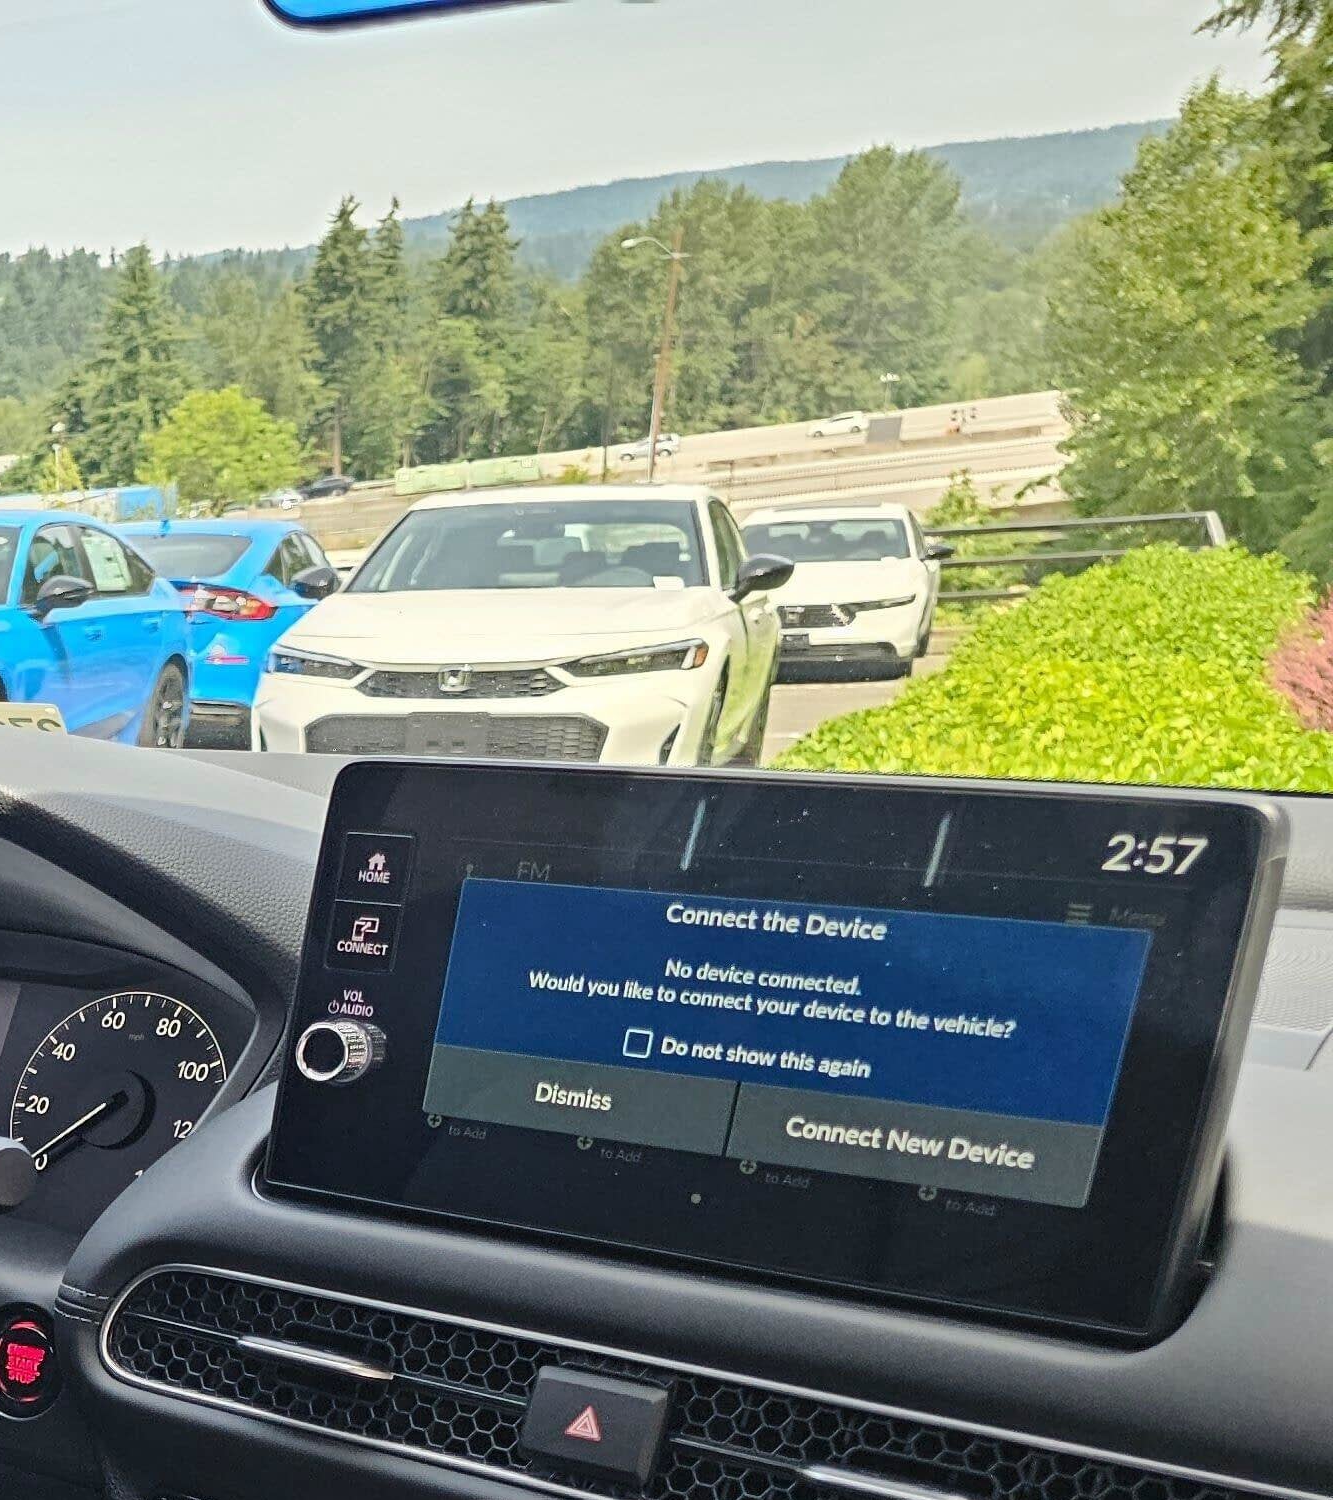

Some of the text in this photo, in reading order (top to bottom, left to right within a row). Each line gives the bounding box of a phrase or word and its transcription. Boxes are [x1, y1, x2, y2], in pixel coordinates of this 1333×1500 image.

[1101, 834, 1209, 875] 2:57
[358, 870, 390, 884] HOME
[517, 861, 550, 881] FM
[666, 902, 887, 941] Connect the Device
[337, 940, 388, 956] CONNECT
[665, 958, 861, 996] No device connected.
[343, 989, 364, 1002] VOL
[529, 970, 1017, 1039] Would you like to connect your device to the vehicle?
[101, 1011, 126, 1029] 60
[340, 1003, 374, 1017] AUDIO
[128, 1033, 145, 1042] mph
[155, 1018, 181, 1038] 80
[51, 1042, 75, 1062] 40
[661, 1036, 872, 1079] Do not show this again
[177, 1060, 209, 1082] 100
[25, 1095, 49, 1115] 20
[534, 1080, 613, 1111] Dismiss
[173, 1119, 193, 1139] 12
[448, 1125, 487, 1140] to Add
[786, 1116, 1036, 1170] Connect New Device
[34, 1153, 48, 1171] 0
[600, 1148, 642, 1163] to Add
[765, 1172, 810, 1189] to Add
[945, 1200, 996, 1217] to Add
